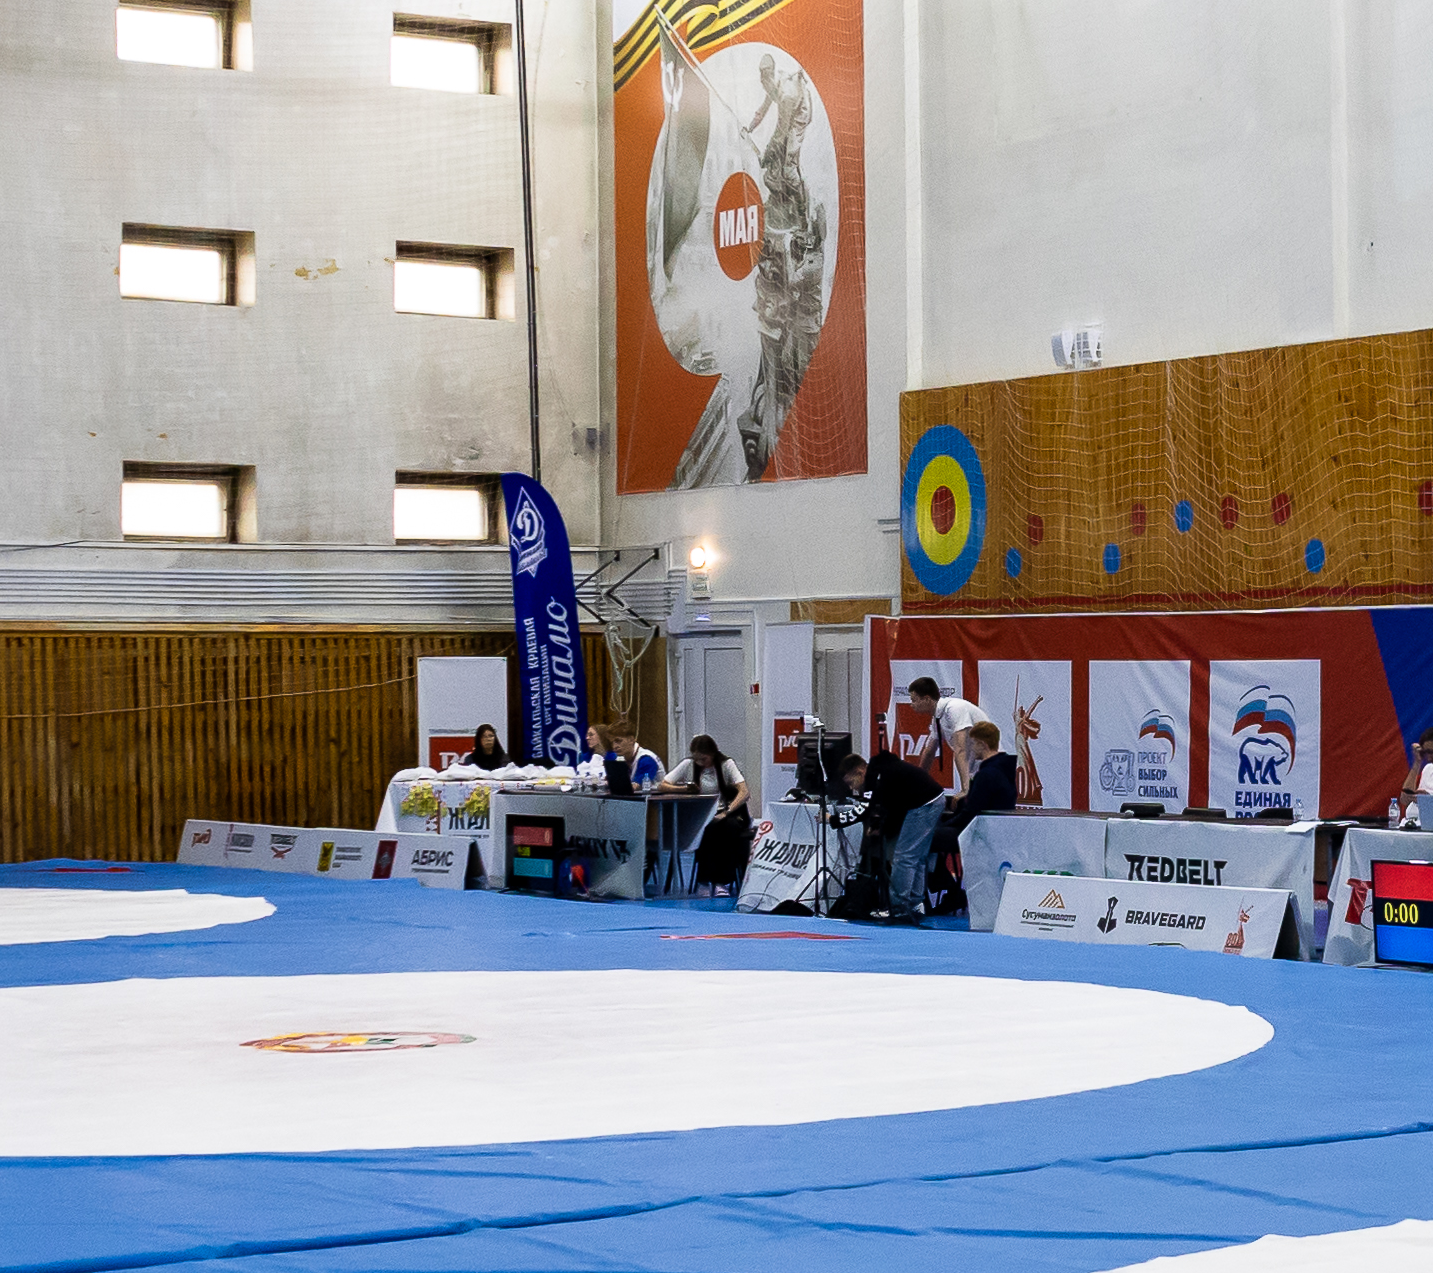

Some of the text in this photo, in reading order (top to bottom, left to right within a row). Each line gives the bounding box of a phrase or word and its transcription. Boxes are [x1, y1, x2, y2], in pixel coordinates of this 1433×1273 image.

[719, 205, 758, 248] МАЯ
[523, 616, 539, 669] КРАЕВАЯ
[1137, 751, 1167, 764] ПРОЕКТ
[1138, 768, 1167, 781] ВЫБОР
[1138, 785, 1179, 799] СИЛЬНЫХ
[1234, 790, 1291, 809] ЕДИНАЯ
[411, 849, 455, 868] АБРИС
[1123, 853, 1228, 886] REDBELT
[1125, 909, 1206, 932] BRAVEGARD
[1384, 902, 1419, 924] 0:00
